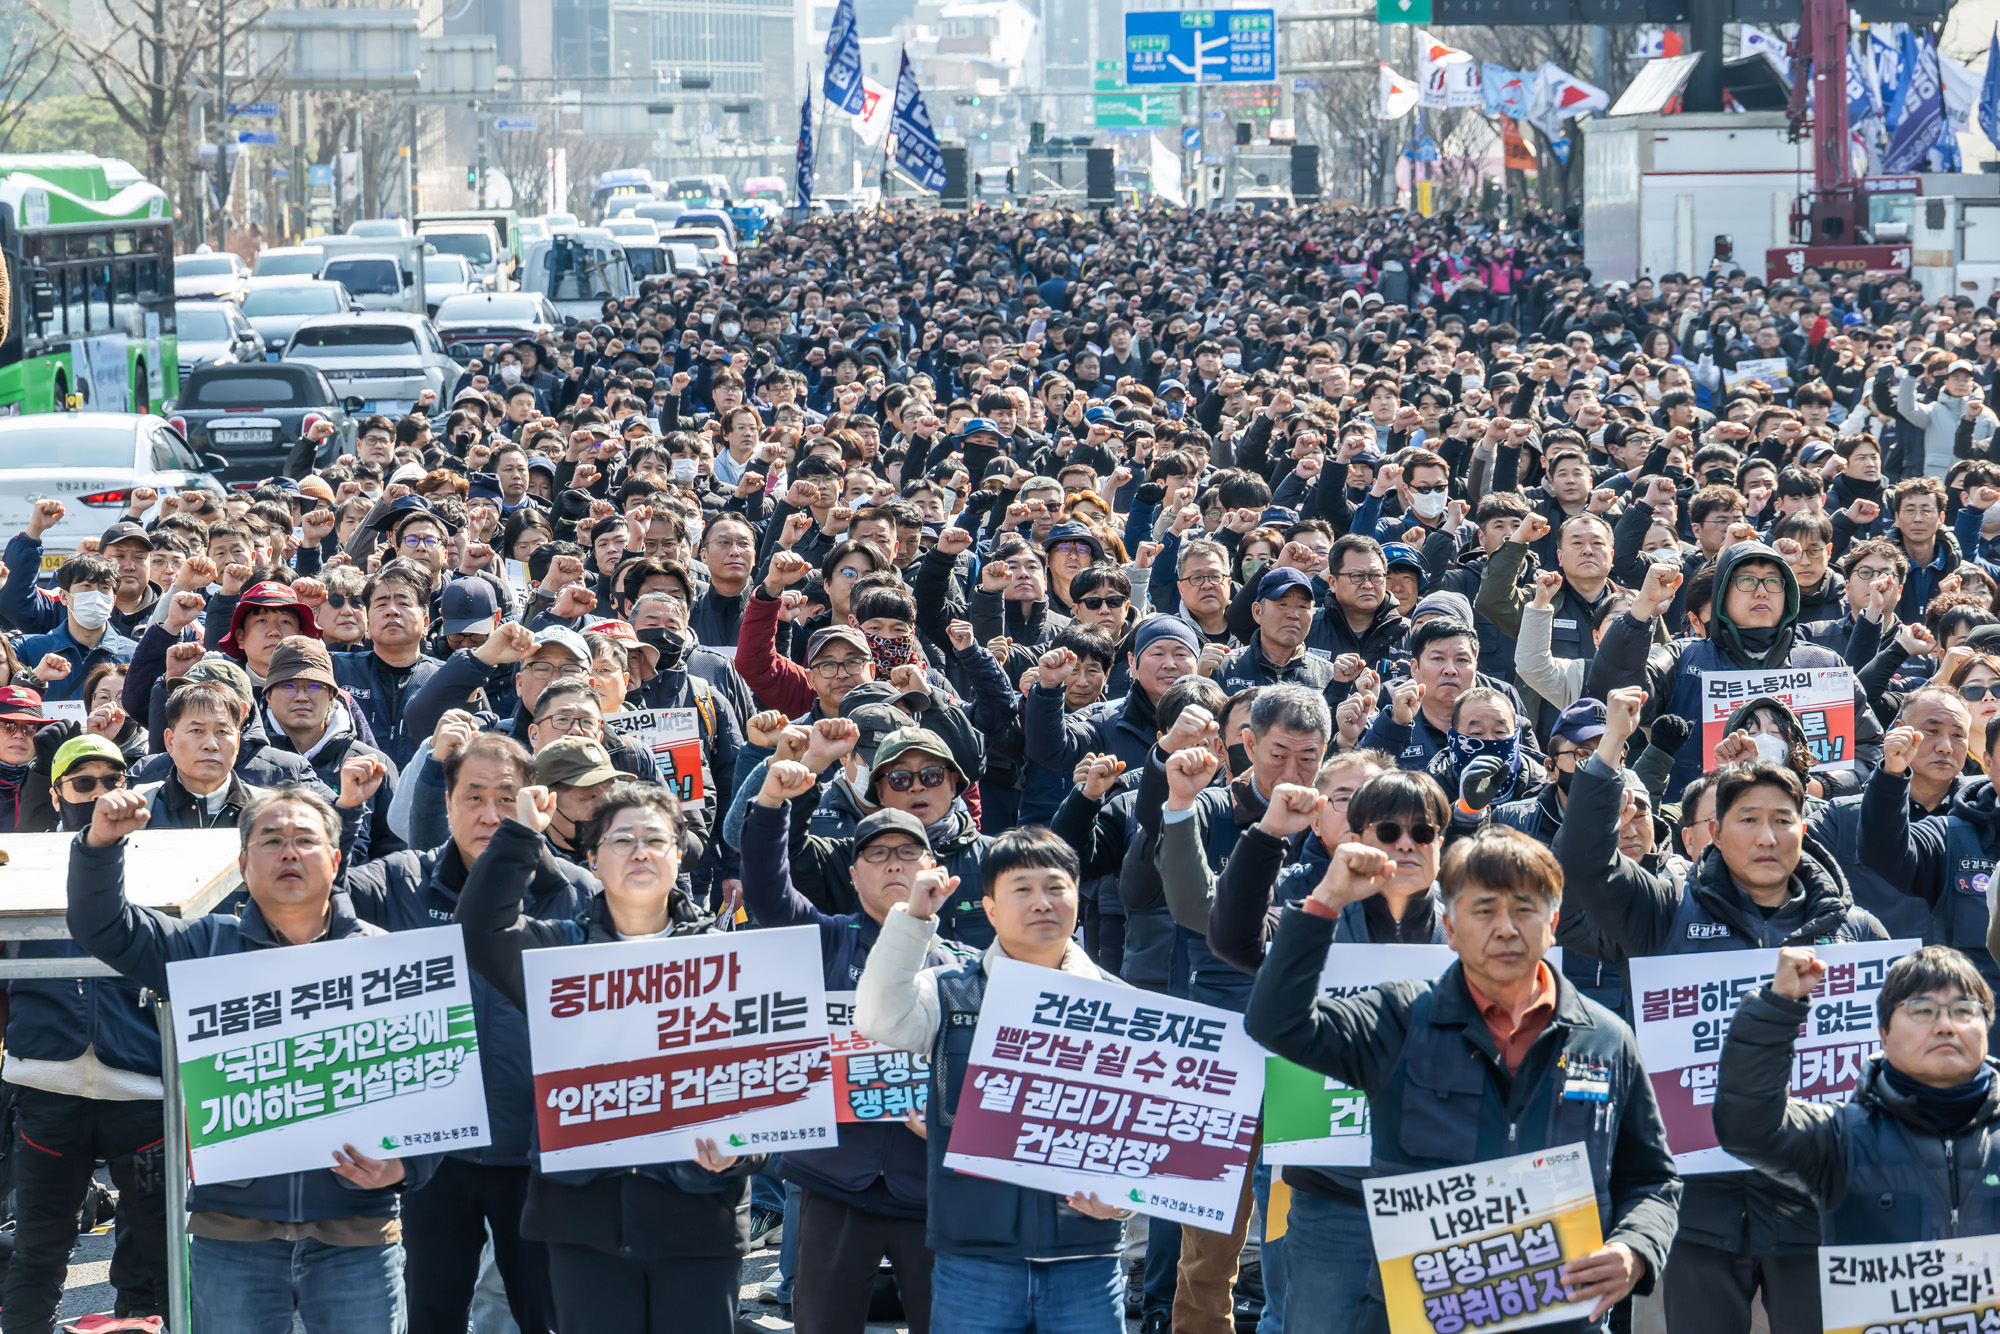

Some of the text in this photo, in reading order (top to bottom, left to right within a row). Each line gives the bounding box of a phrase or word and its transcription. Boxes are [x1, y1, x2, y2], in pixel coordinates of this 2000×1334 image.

[1785, 250, 1805, 273] 형
[1891, 247, 1910, 269] 제
[243, 431, 268, 441] 0836
[1708, 672, 1812, 698] 모든 노동자의
[188, 955, 456, 1042] 고품질 주택 건설로
[550, 951, 741, 1018] 중대재해가
[293, 1010, 450, 1072] 주거안정에
[657, 991, 808, 1050] 감소되는
[1032, 991, 1227, 1052] 건설노동자도
[1815, 1000, 1873, 1036] 없는
[992, 1025, 1238, 1096] 빨간날 쉴 수 있는
[201, 1079, 325, 1136] 기여하는
[1021, 1079, 1132, 1131] 권리가
[1131, 1097, 1243, 1149] 보장된
[403, 1126, 479, 1146] 전국건설노동조합
[750, 1127, 827, 1144] 전국건설노동조합
[1150, 1194, 1224, 1221] 전국건설노동조합
[1372, 1173, 1476, 1216] 진짜사장
[1429, 1187, 1530, 1240] 나와라!
[1412, 1221, 1562, 1293] 원청교섭
[1828, 1249, 1945, 1285] 진짜사장
[1891, 1267, 1994, 1313] 나와라!
